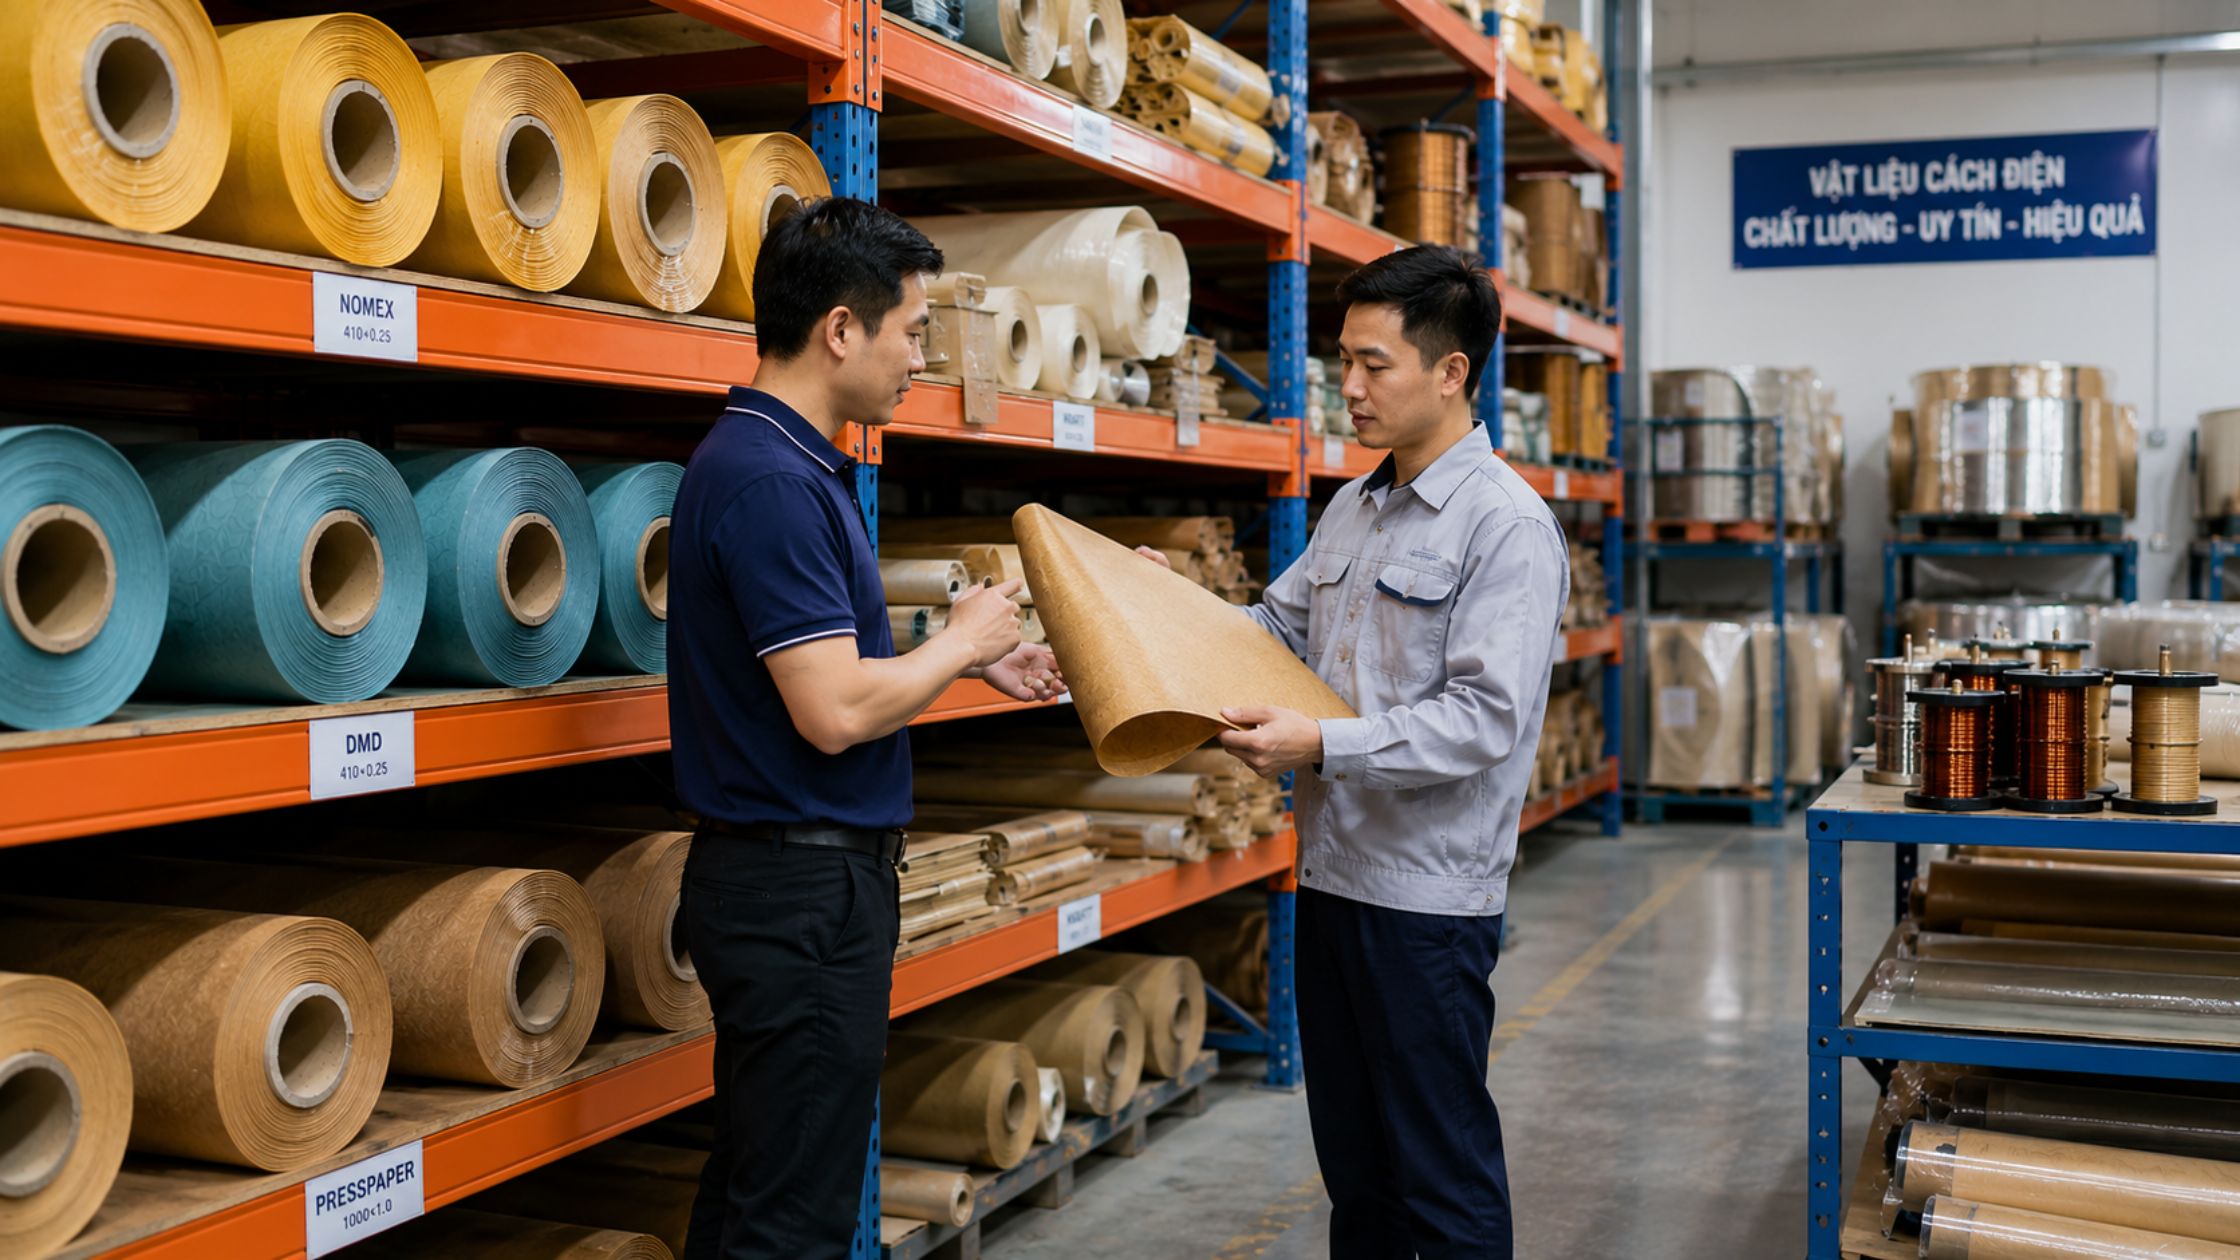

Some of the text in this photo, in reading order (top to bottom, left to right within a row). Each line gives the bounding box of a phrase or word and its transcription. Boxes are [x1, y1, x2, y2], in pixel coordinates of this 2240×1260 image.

[1809, 150, 2065, 203] VẬT LIỆU CÁCH ĐIỆN
[1743, 205, 1810, 249] CHẤT
[1814, 210, 1898, 251] LƯỢNG
[1919, 210, 1955, 242] UY
[1958, 202, 2002, 241] TÍN
[2023, 198, 2084, 244] HIỆU
[2089, 192, 2145, 239] QUẢ
[340, 293, 394, 319] NOMEX
[346, 732, 382, 754] DMD
[316, 1160, 415, 1216] PRESSPAPER
